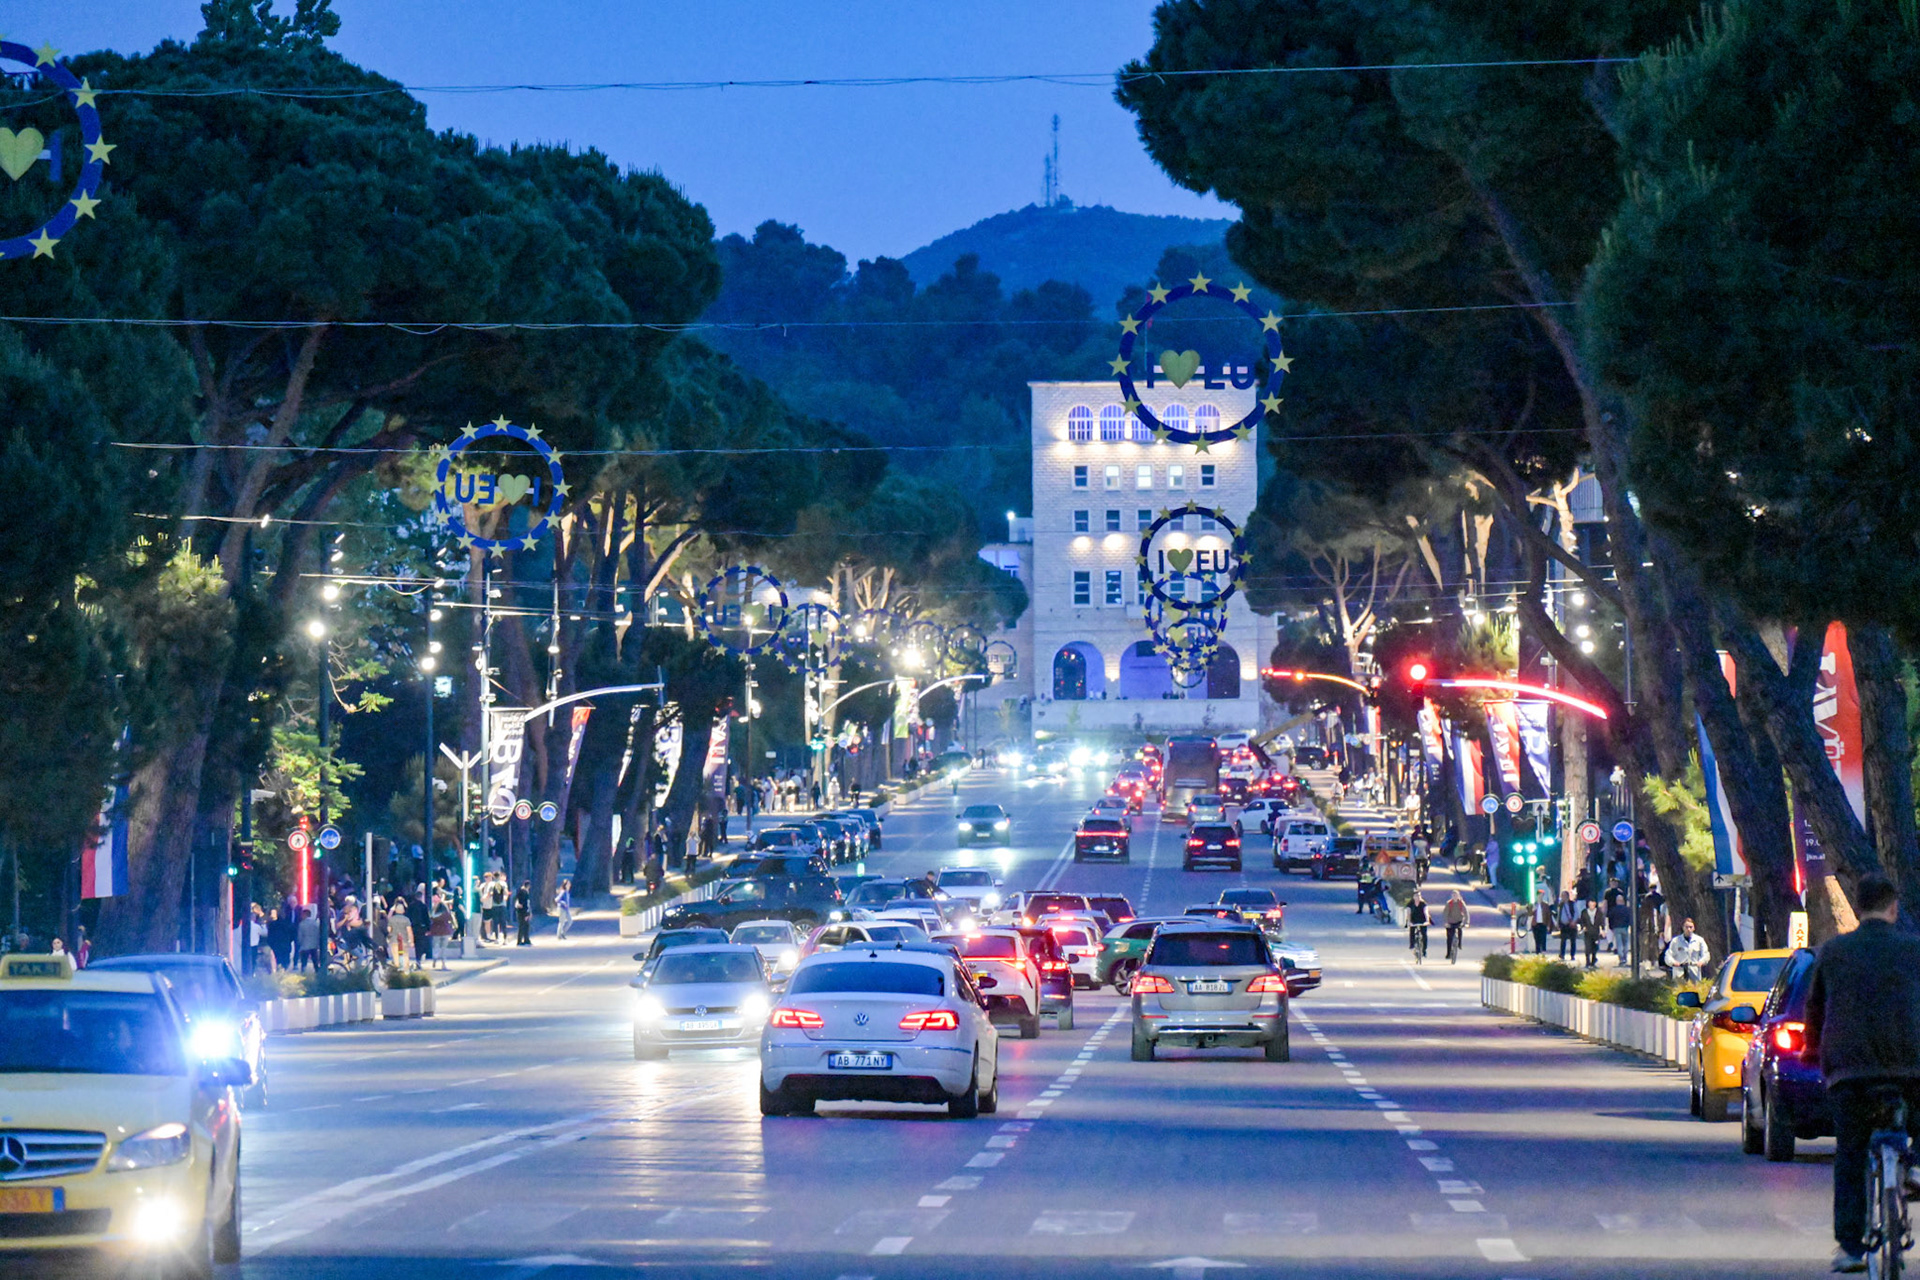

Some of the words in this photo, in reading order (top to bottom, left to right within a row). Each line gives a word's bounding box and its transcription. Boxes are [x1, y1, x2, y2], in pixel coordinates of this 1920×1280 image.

[1158, 549, 1165, 574] I
[1196, 549, 1230, 574] EU
[1795, 922, 1805, 949] TAXI
[837, 1055, 850, 1066] AB
[855, 1055, 886, 1066] 771NY
